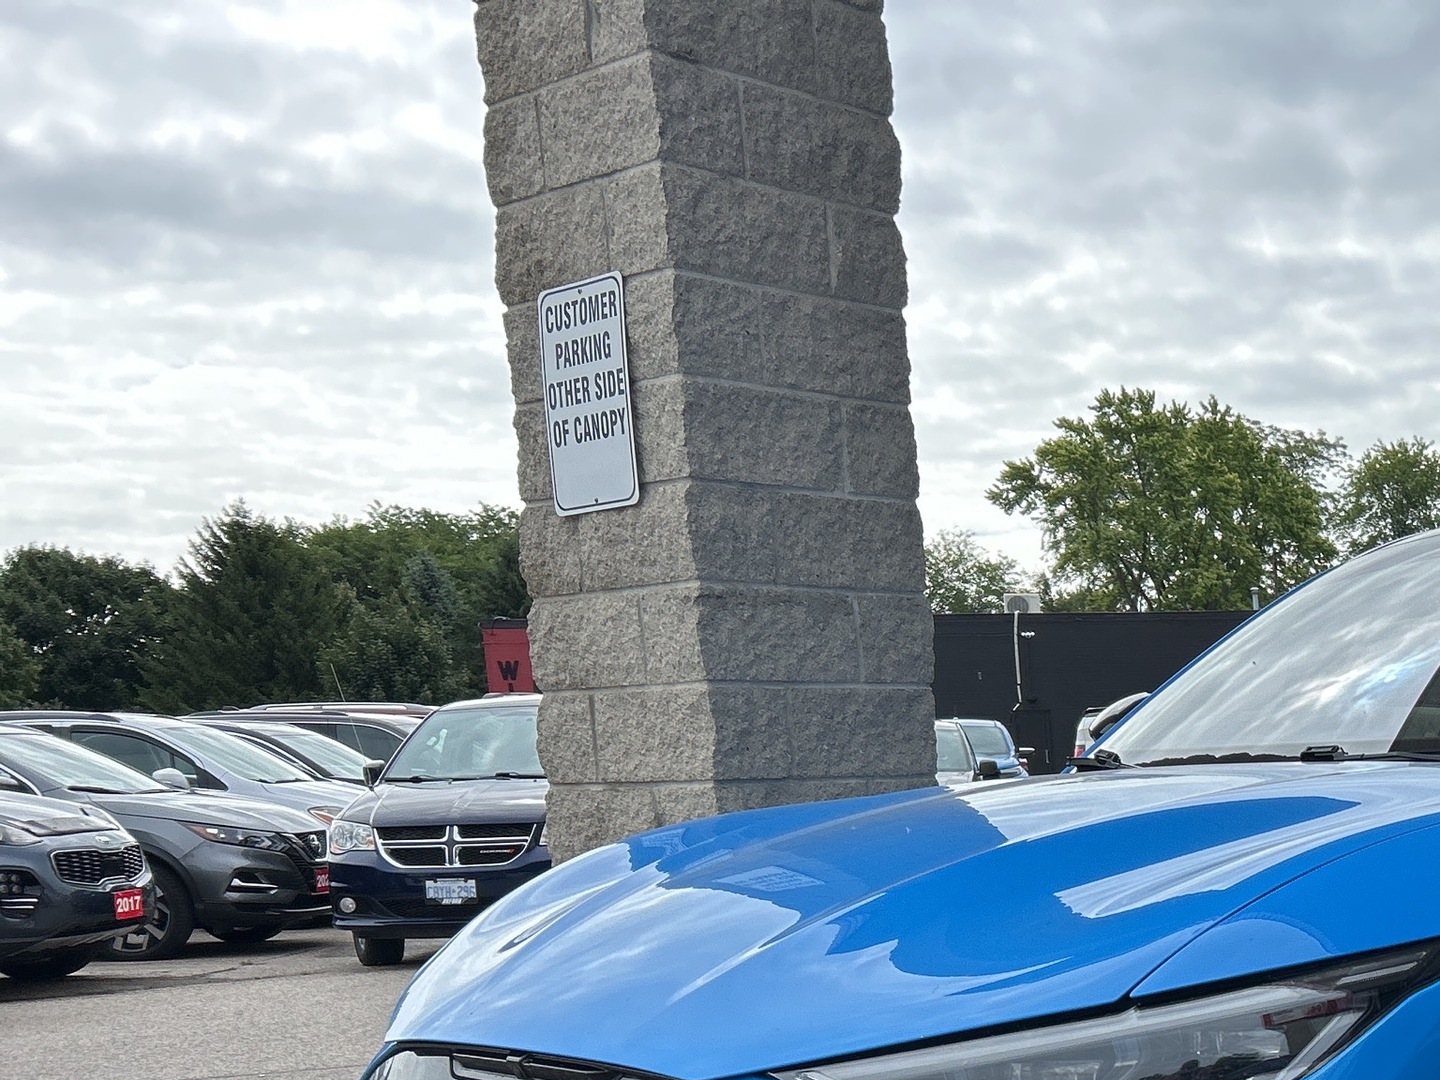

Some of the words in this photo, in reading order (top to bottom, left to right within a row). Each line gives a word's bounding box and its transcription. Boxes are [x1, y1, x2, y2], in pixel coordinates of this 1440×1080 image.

[545, 290, 618, 334] CUSTOMER
[555, 330, 612, 370] PARKING
[548, 376, 591, 411] OTHER
[594, 368, 625, 401] SIDE
[553, 419, 570, 448] OF
[574, 407, 626, 444] CANOPY
[116, 895, 141, 912] 2017
